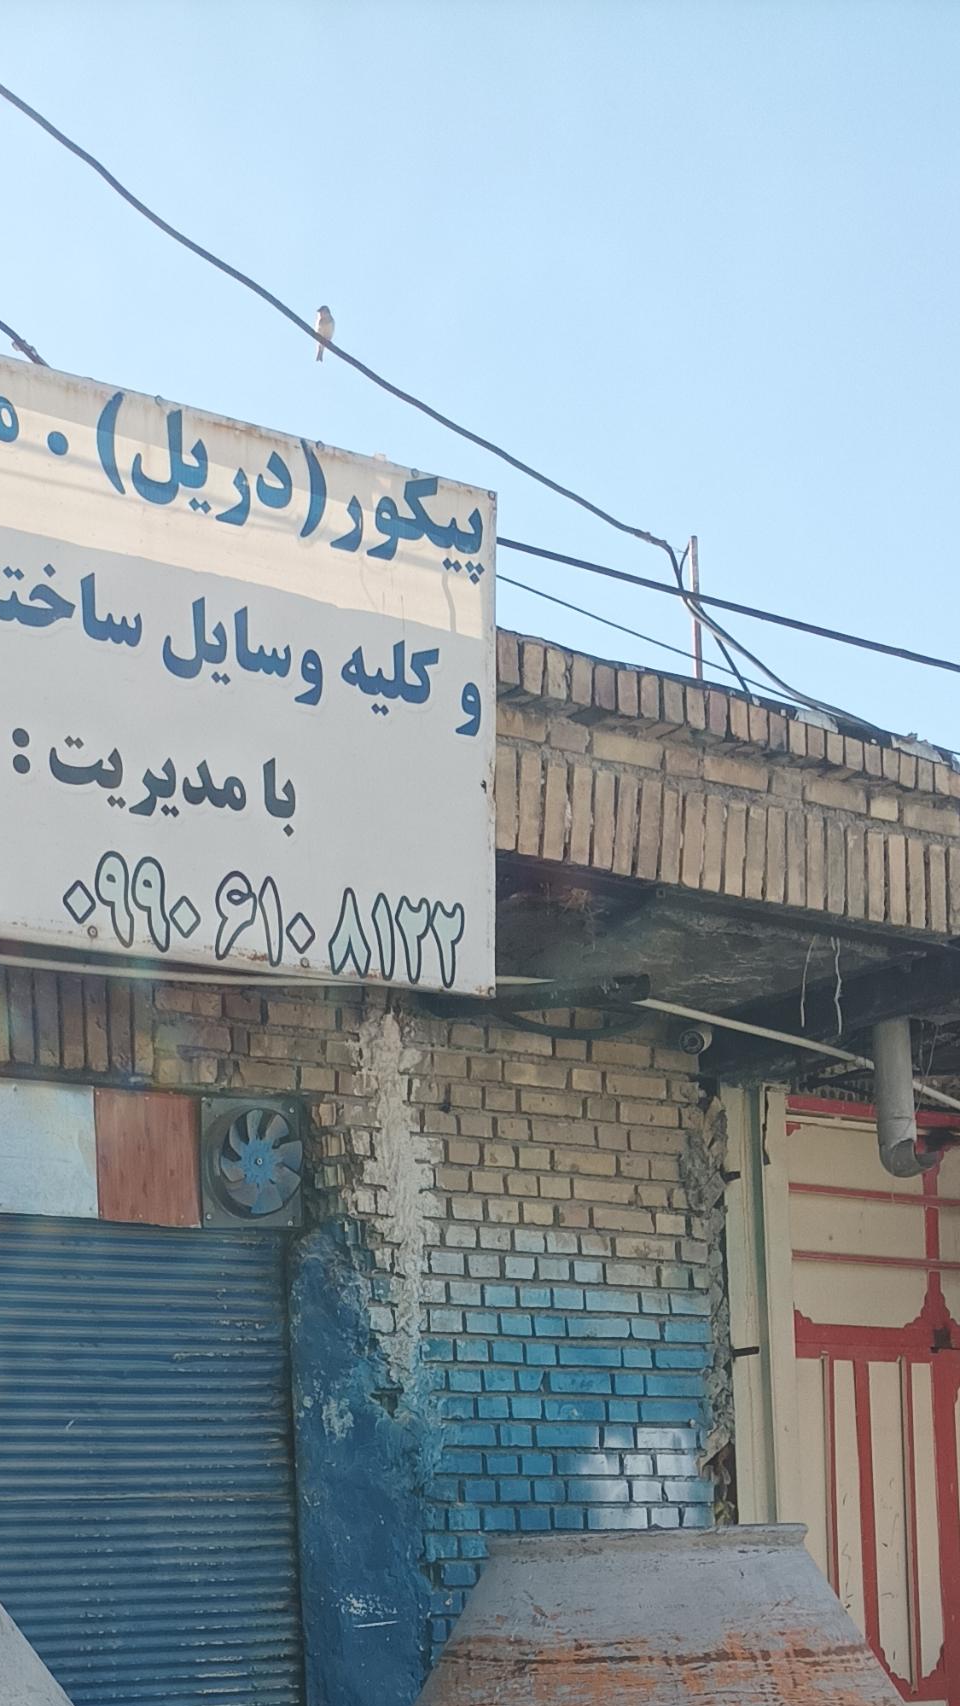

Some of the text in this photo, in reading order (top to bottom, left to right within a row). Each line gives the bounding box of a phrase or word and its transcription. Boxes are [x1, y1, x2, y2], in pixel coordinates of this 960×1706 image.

[161, 596, 323, 706] وسایل
[340, 641, 439, 716] کلیه
[455, 682, 482, 736] و
[262, 758, 296, 837] با
